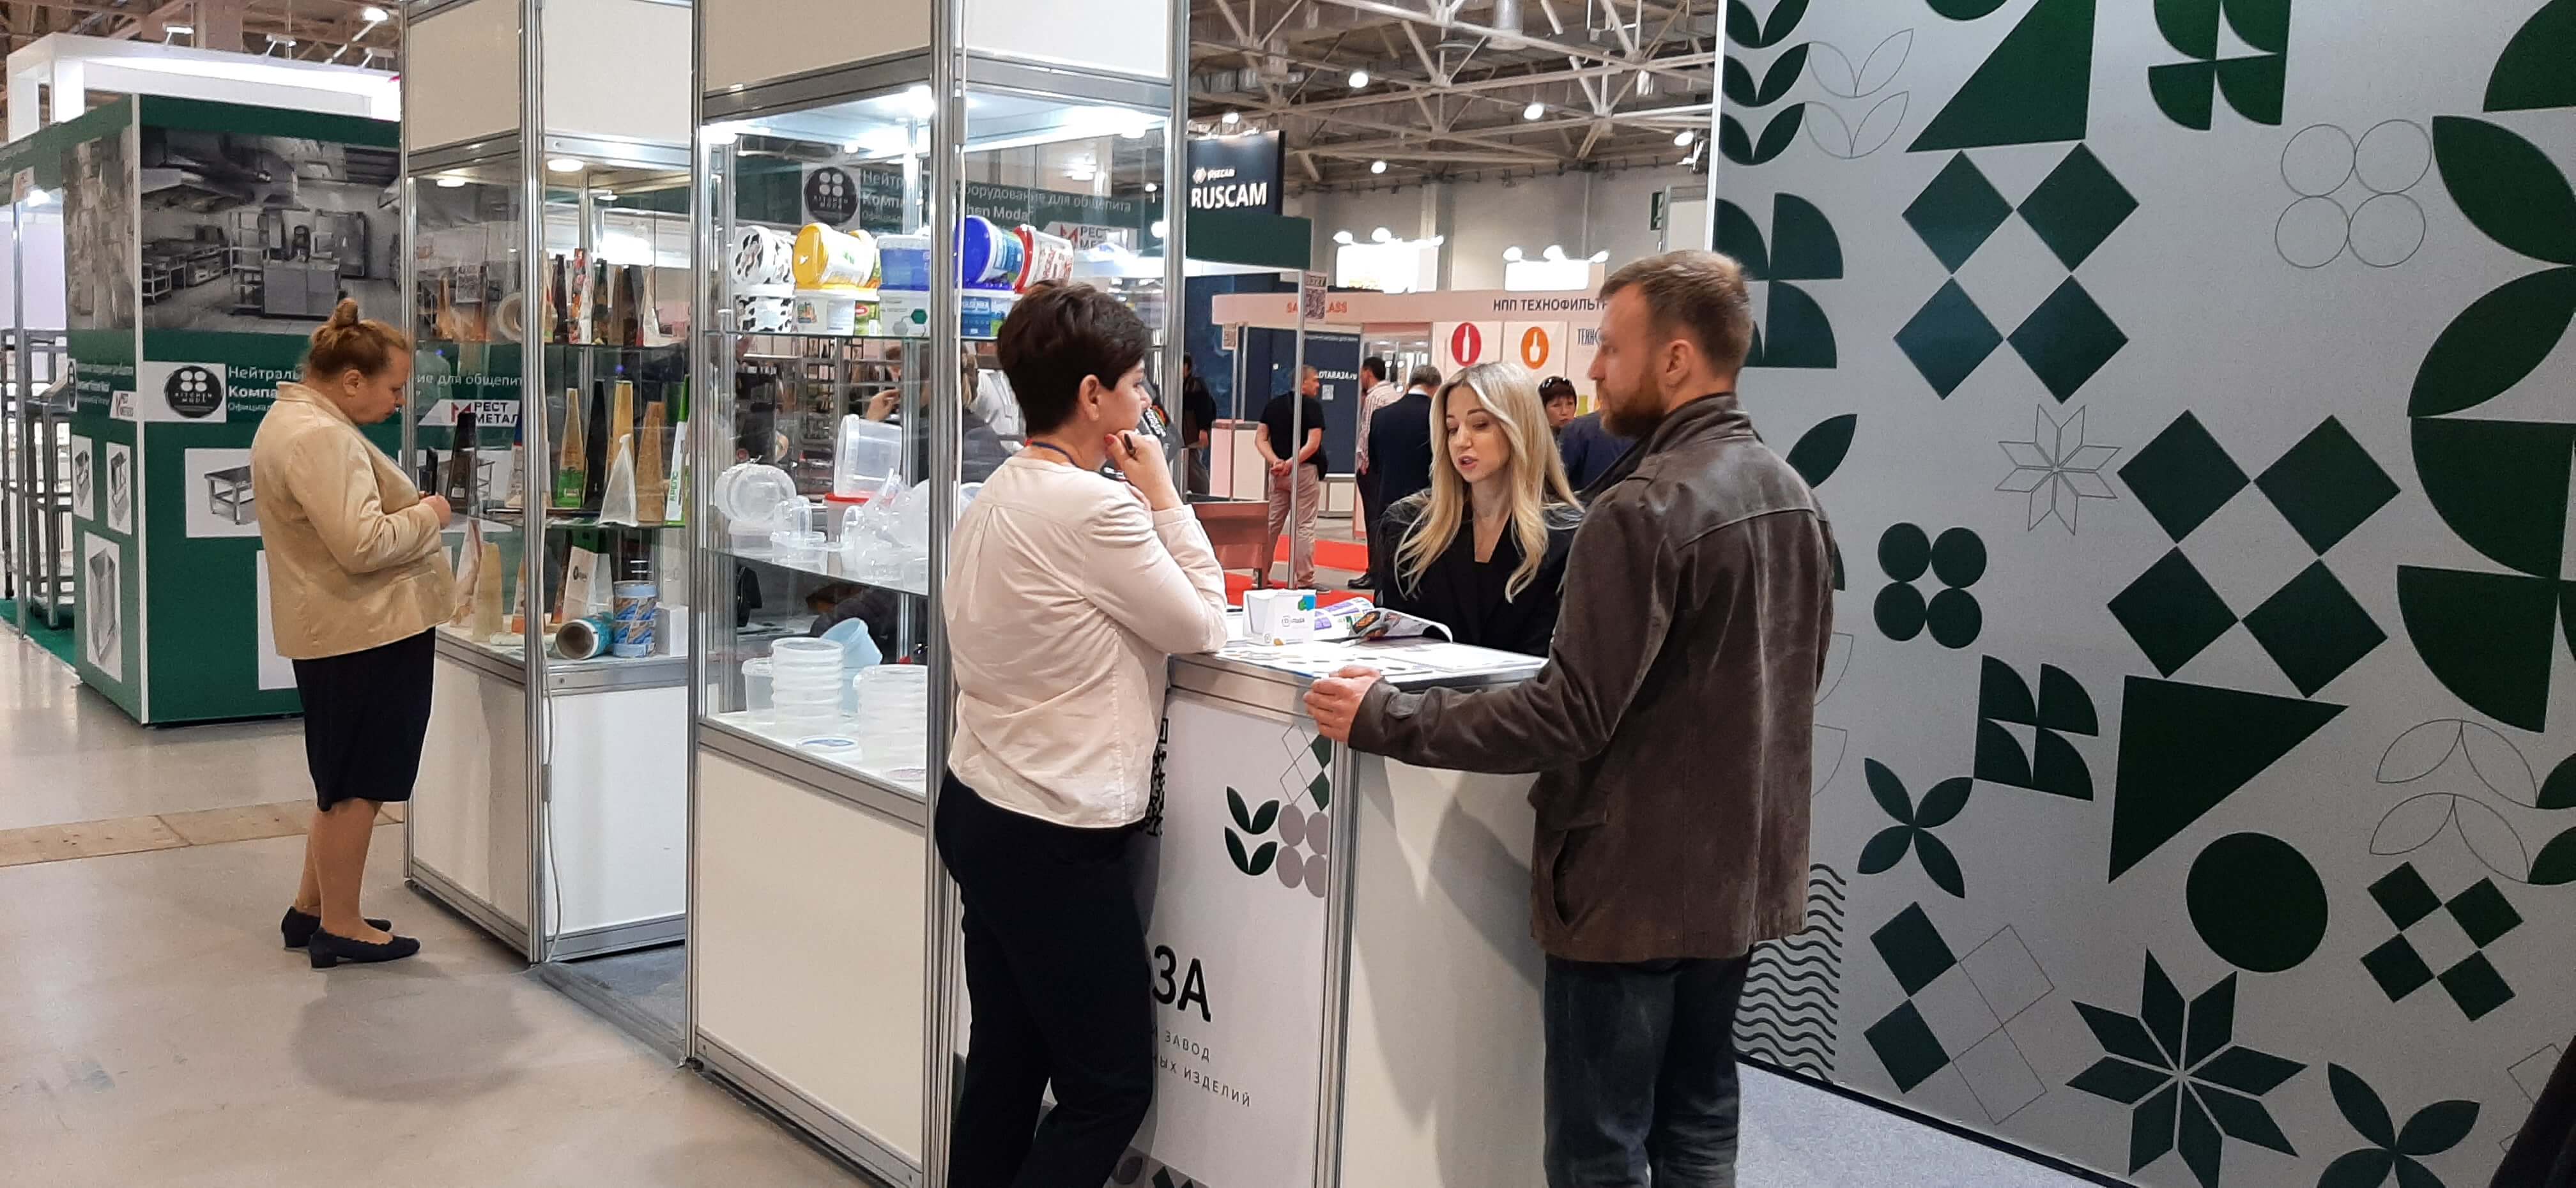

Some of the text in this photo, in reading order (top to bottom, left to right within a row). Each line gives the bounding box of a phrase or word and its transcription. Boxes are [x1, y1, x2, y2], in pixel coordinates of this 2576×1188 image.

[1048, 196, 1070, 206] для
[1192, 182, 1267, 209] RUSCAM
[1493, 299, 1517, 311] НПП
[228, 365, 303, 381] Нейтраль
[438, 376, 461, 387] для
[466, 374, 523, 387] общепит
[229, 386, 277, 398] Компа
[475, 402, 507, 412] РЕСТ
[475, 414, 518, 423] МЕТАЛ
[1152, 945, 1211, 1022] ЗА
[1165, 1030, 1210, 1063] ЗАВОД
[1159, 1055, 1250, 1108] ЫХ ИЗДЕЛИЙ
